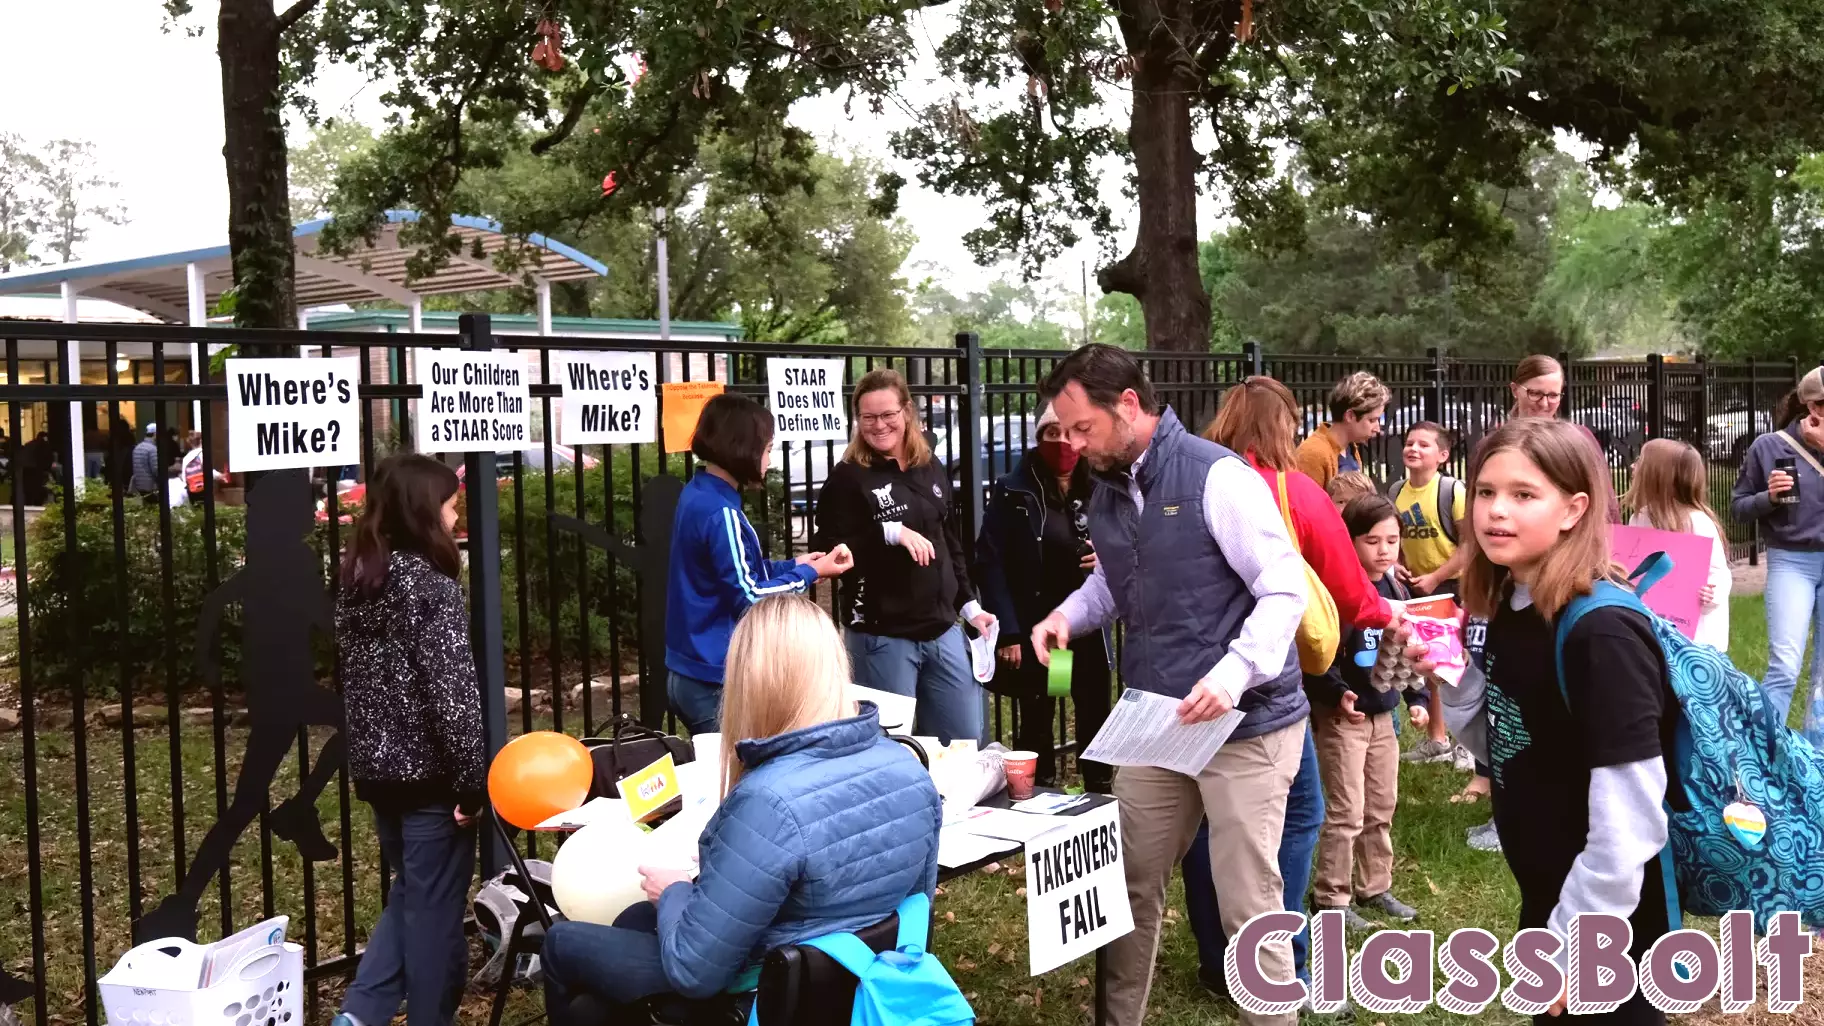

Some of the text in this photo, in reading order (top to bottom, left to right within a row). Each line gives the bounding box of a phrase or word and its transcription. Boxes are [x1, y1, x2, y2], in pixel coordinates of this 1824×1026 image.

[431, 361, 520, 386] Our Children
[567, 362, 649, 391] Where's
[784, 367, 827, 386] STAAR
[237, 371, 351, 407] Where's
[431, 390, 523, 414] Are More Than
[777, 390, 835, 409] Does NOT
[431, 418, 523, 442] a STAAR Score
[581, 403, 641, 433] Mike?
[777, 413, 841, 432] Define Me
[256, 419, 341, 456] Mike?
[1031, 820, 1118, 896] TAKEOVERS
[1058, 885, 1108, 945] FAIL
